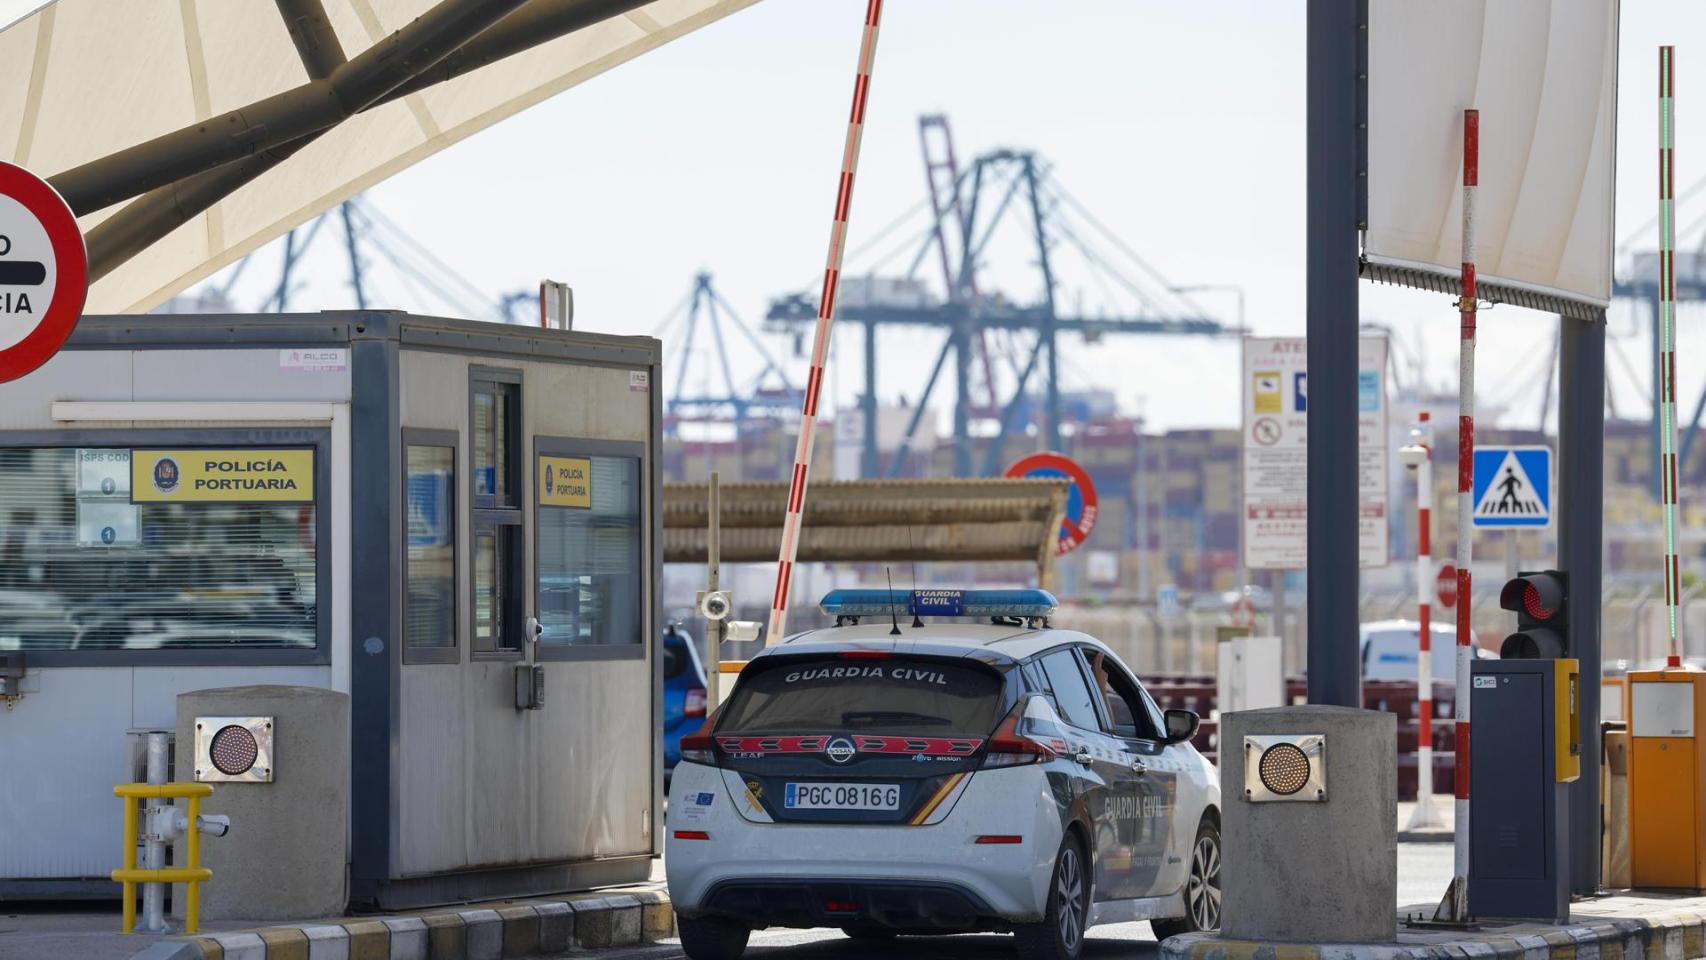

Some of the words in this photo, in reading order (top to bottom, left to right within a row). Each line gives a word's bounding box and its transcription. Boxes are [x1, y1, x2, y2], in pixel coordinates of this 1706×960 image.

[0, 293, 32, 314] IA
[1272, 341, 1307, 354] ATE
[108, 453, 130, 462] COD
[204, 459, 287, 472] POLICÍA
[194, 479, 297, 490] PORTUARIA
[921, 597, 950, 605] CIVIL
[785, 666, 883, 683] GUARDIA
[891, 668, 947, 685] CIVIL
[798, 786, 832, 806] PGC
[835, 786, 882, 806] 0816
[886, 788, 897, 806] G
[1104, 797, 1141, 819] GUARDIA
[1143, 795, 1162, 817] CIVIL
